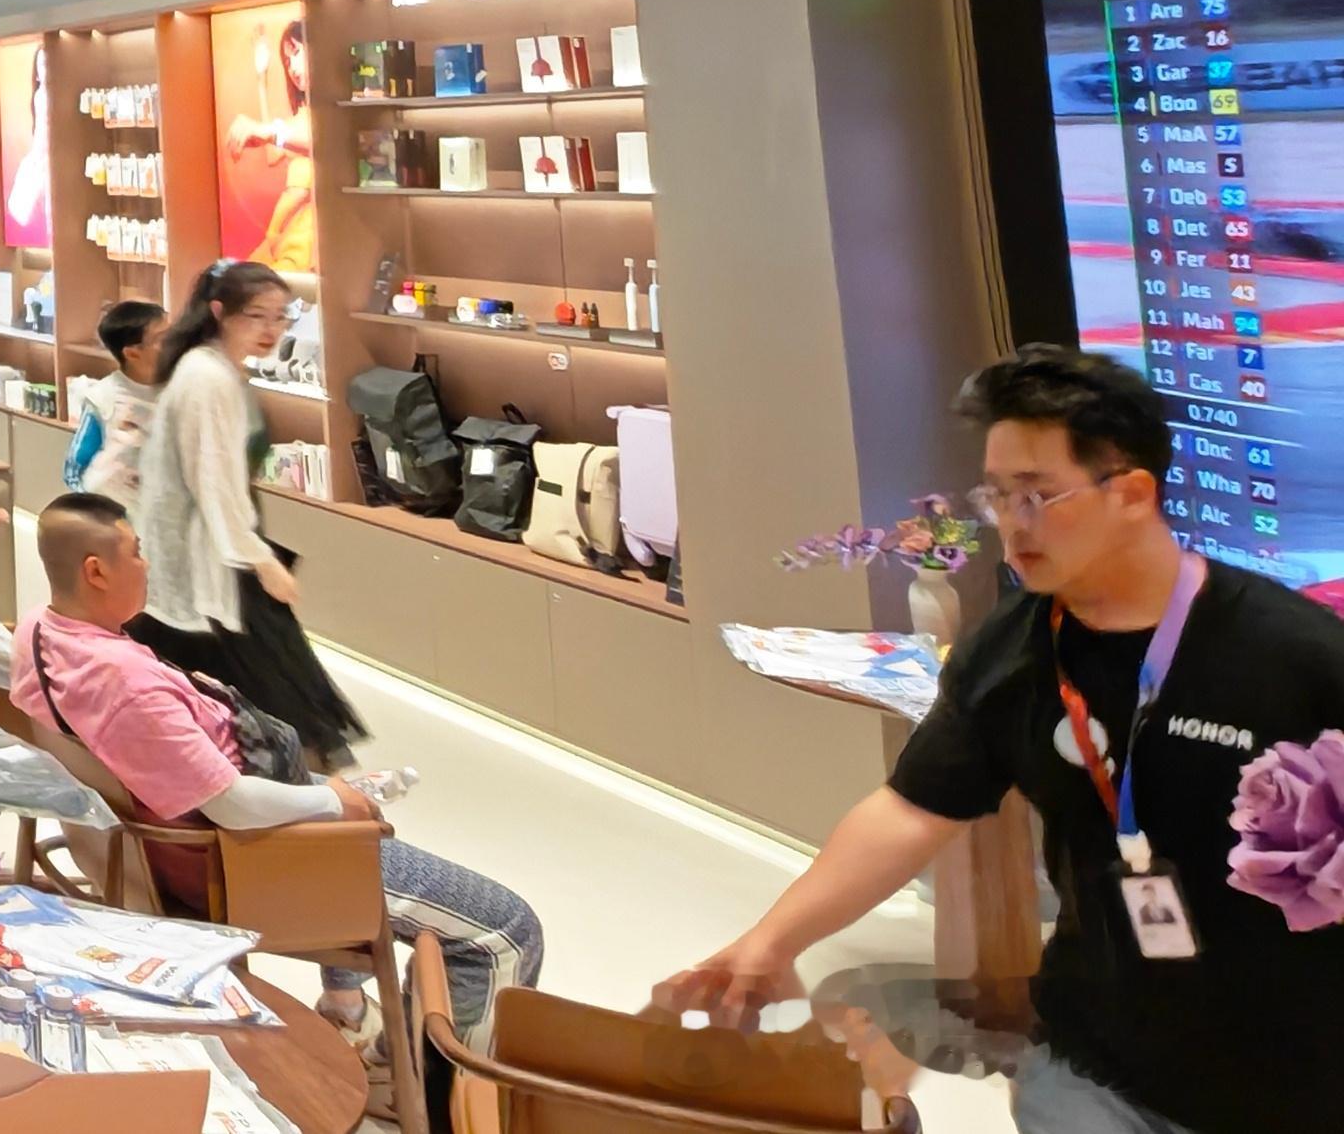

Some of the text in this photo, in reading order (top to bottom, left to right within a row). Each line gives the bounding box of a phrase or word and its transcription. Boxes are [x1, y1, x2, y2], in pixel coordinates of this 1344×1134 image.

[1125, 6, 1135, 22] 1
[1150, 3, 1183, 19] Are
[1127, 30, 1230, 52] 2 Zac 16
[1131, 66, 1144, 82] 3
[1156, 64, 1190, 81] Gar
[1134, 94, 1236, 112] 4 Boo 69
[1137, 126, 1150, 143] 5
[1214, 124, 1238, 141] 57
[1140, 157, 1237, 174] 6 Mas 5
[1143, 188, 1155, 204] 7
[1221, 189, 1247, 206] 53
[1147, 219, 1160, 235] 8
[1225, 221, 1249, 237] 65
[1150, 249, 1252, 269] 9 Fer 11
[1144, 279, 1166, 295] 10
[1231, 285, 1256, 302] 43
[1148, 309, 1259, 332] 11 Mah 94
[1150, 339, 1257, 364] 12 Far 7
[1152, 368, 1265, 398] 13 Cas 40
[1187, 404, 1238, 427] 0.740
[1171, 433, 1183, 451] 4
[1248, 447, 1273, 466] 61
[1196, 470, 1242, 495] Wha
[1251, 482, 1276, 501] 70
[1201, 504, 1232, 527] Alc
[1253, 515, 1279, 536] 52
[1168, 714, 1254, 751] HONOR
